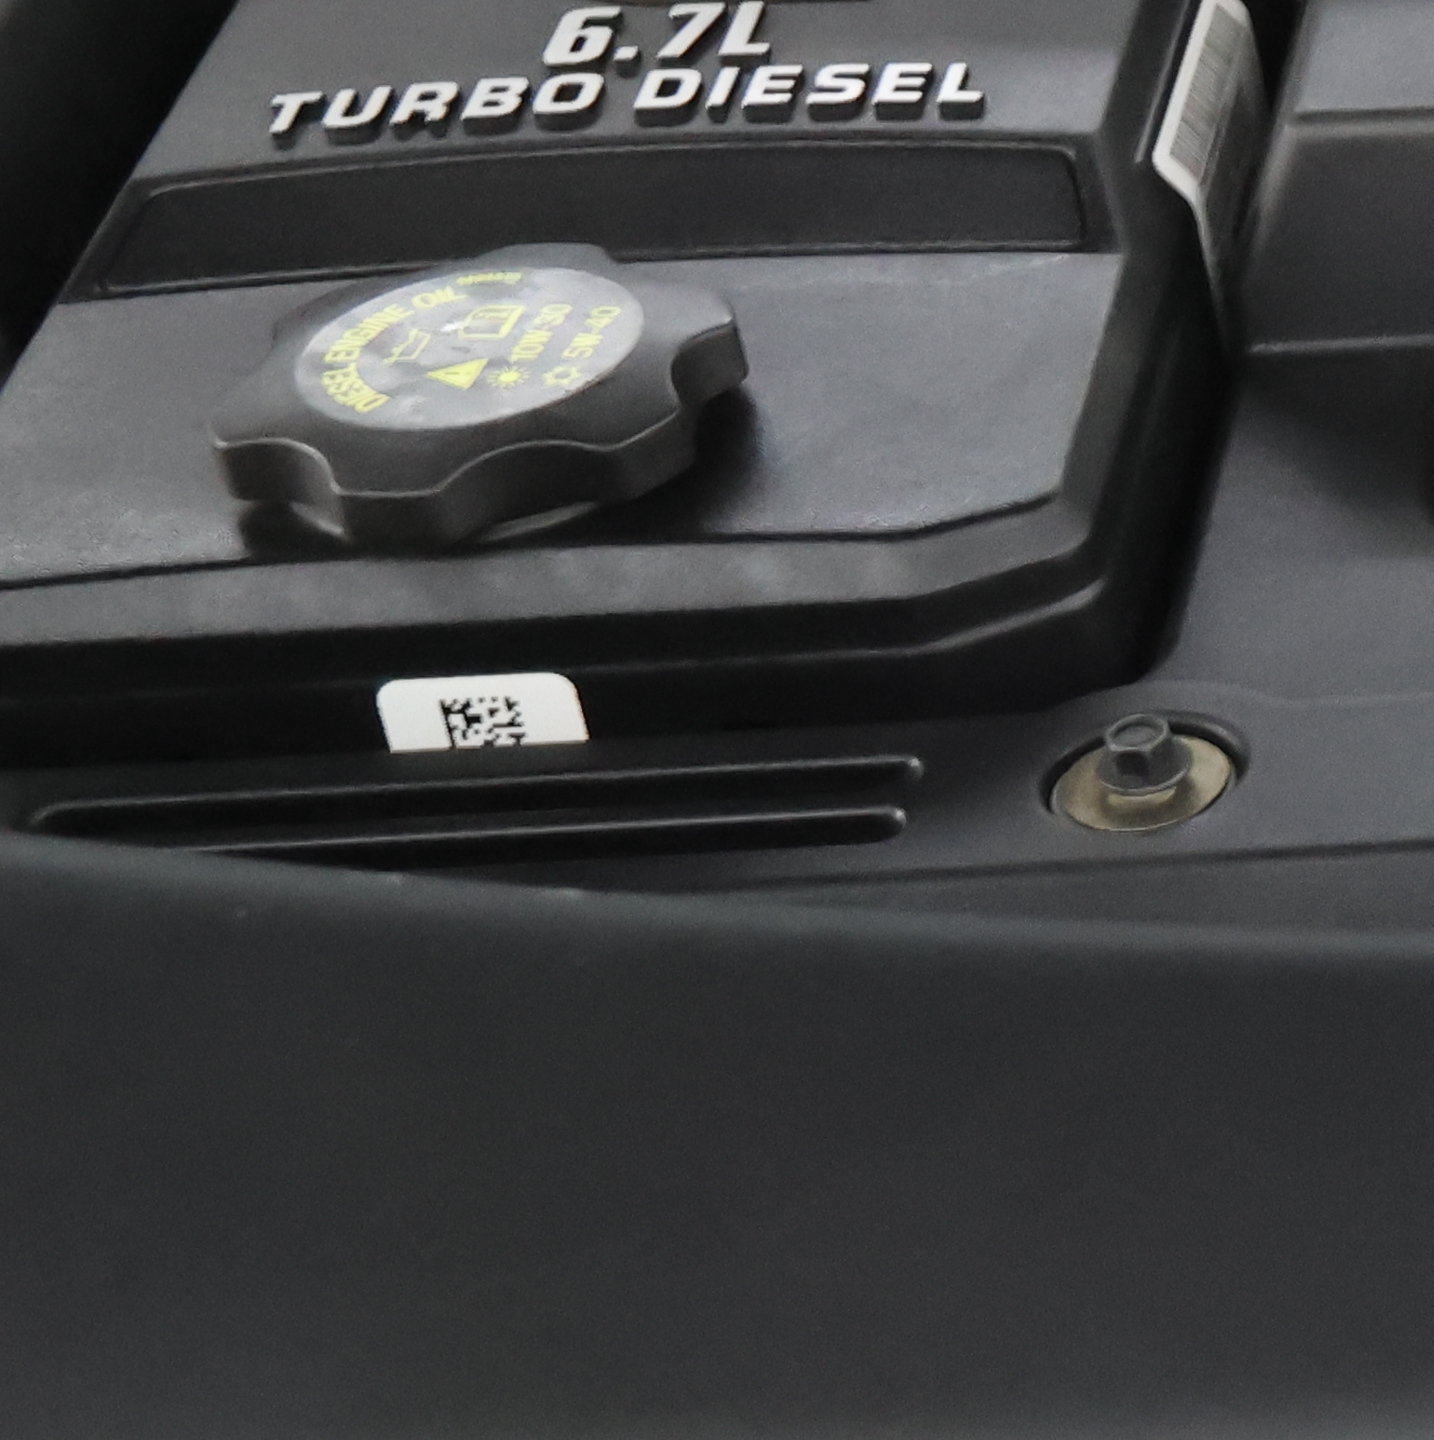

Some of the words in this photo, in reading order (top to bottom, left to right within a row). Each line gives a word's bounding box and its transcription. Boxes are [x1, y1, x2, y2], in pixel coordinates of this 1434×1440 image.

[541, 0, 772, 68] 6.7L
[268, 73, 606, 138] TURBO
[632, 61, 986, 117] DIESEL
[324, 303, 417, 364] ENGINE
